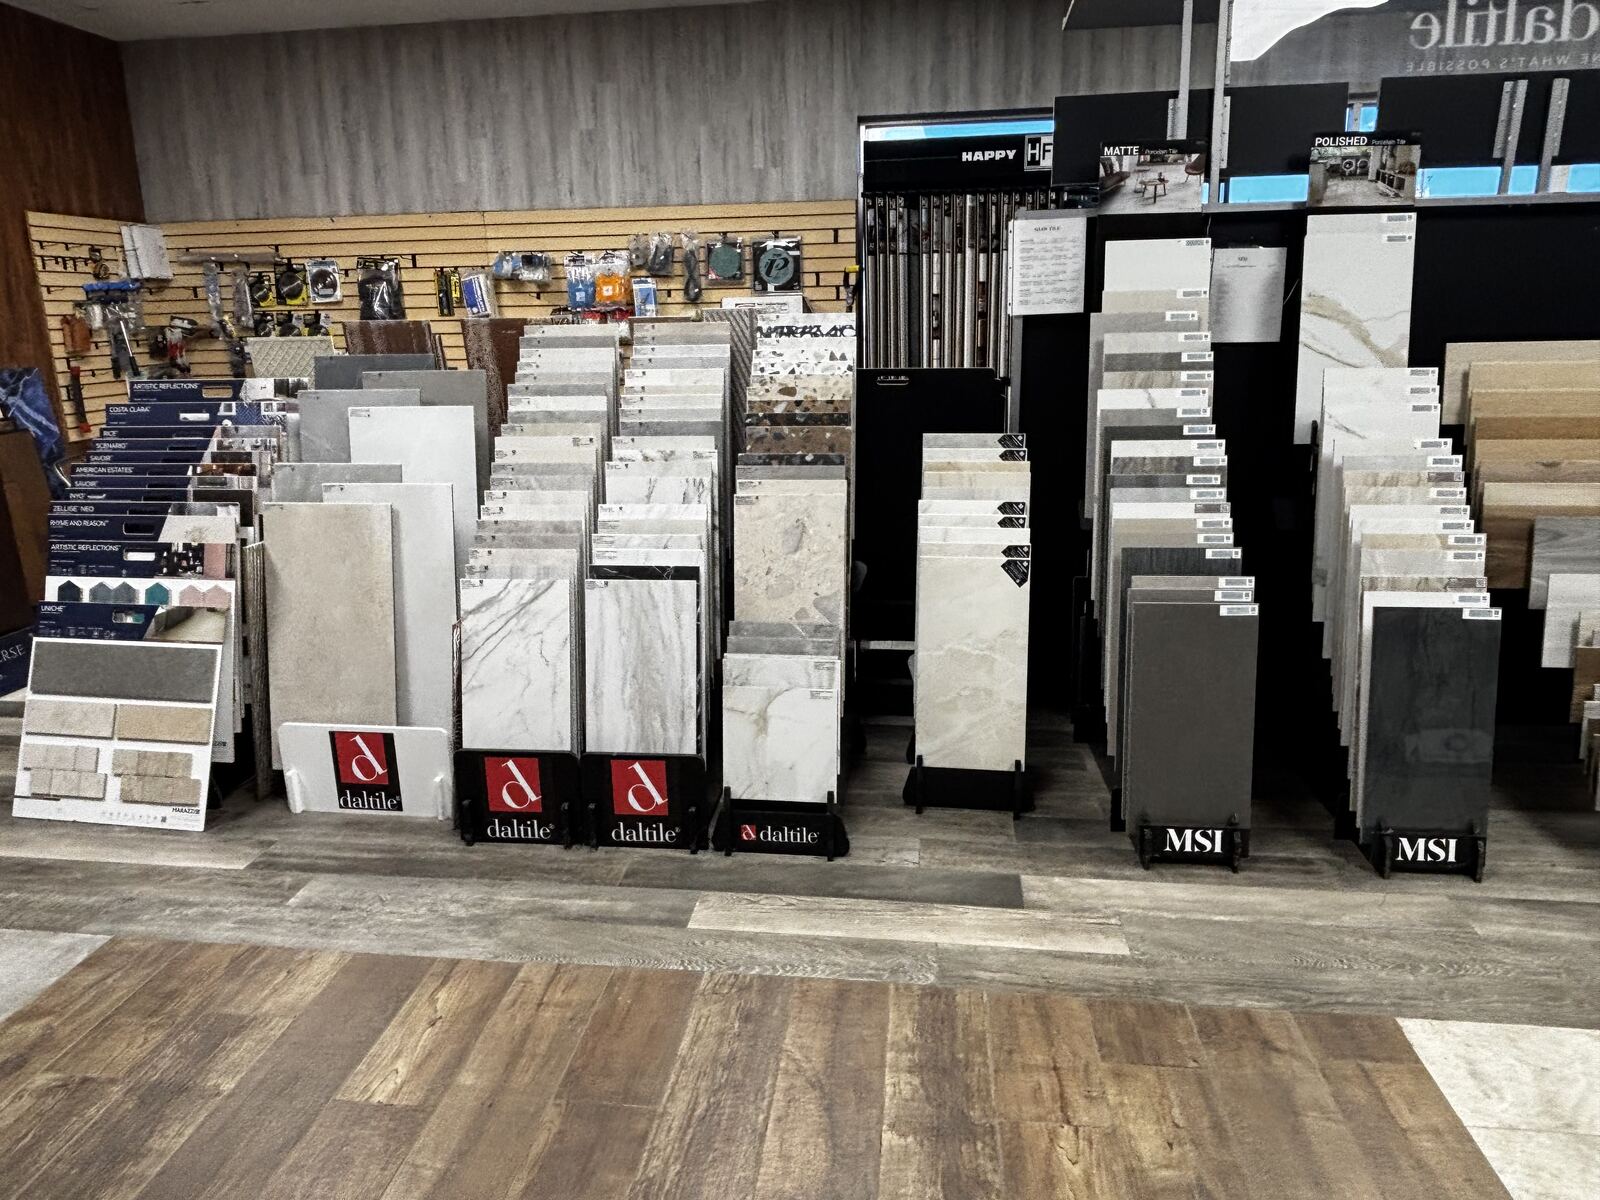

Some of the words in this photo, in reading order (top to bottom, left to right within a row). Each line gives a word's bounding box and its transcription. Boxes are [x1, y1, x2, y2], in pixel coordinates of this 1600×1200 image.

[1314, 136, 1369, 147] POLISHED
[962, 150, 1017, 162] HAPPY
[1103, 146, 1140, 156] MATTE
[49, 519, 69, 527] RHYME
[69, 519, 82, 527] AND
[77, 544, 121, 552] REFLECTIONS
[339, 790, 399, 810] daltile
[487, 818, 555, 839] daltile
[611, 821, 681, 843] daltile
[760, 825, 818, 843] daltile
[1165, 828, 1224, 853] MSI
[1395, 837, 1458, 862] MSI
